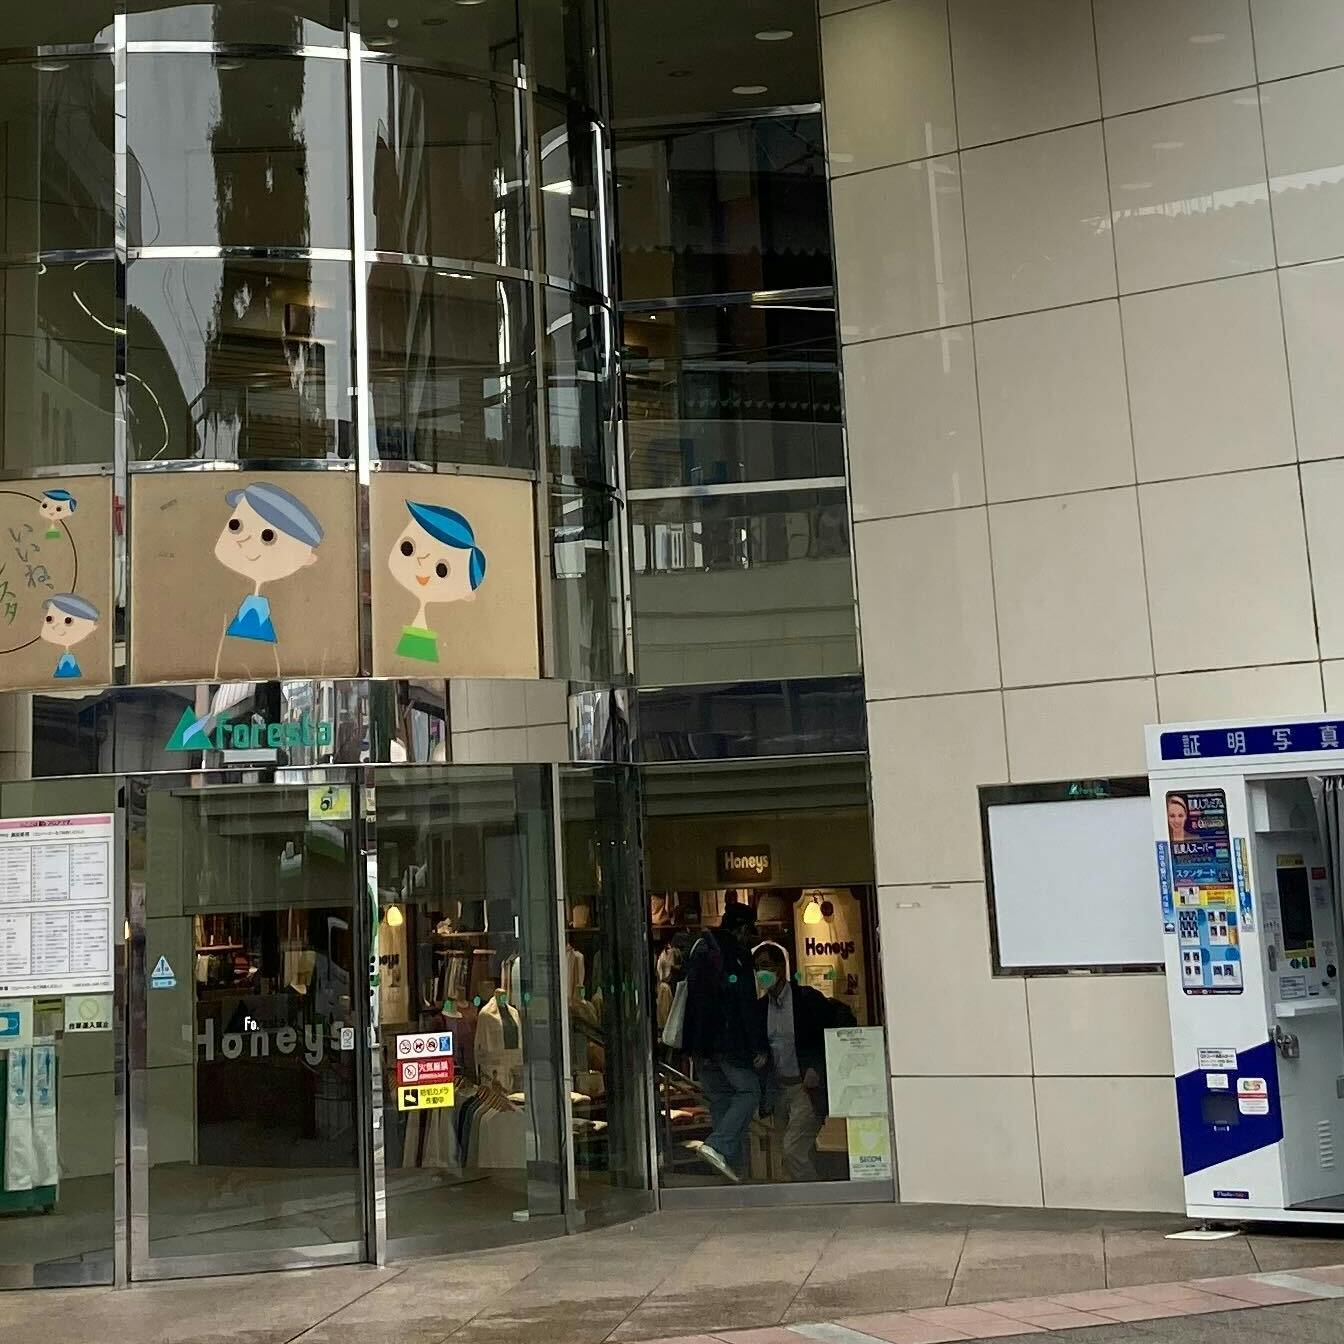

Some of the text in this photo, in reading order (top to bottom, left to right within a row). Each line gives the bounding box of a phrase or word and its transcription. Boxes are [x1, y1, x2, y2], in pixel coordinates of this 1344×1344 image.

[215, 710, 333, 749] Foresta
[1182, 725, 1340, 757] 証明写真
[724, 851, 769, 873] Honeys
[805, 937, 855, 960] Honeys
[196, 1017, 345, 1066] Honeys
